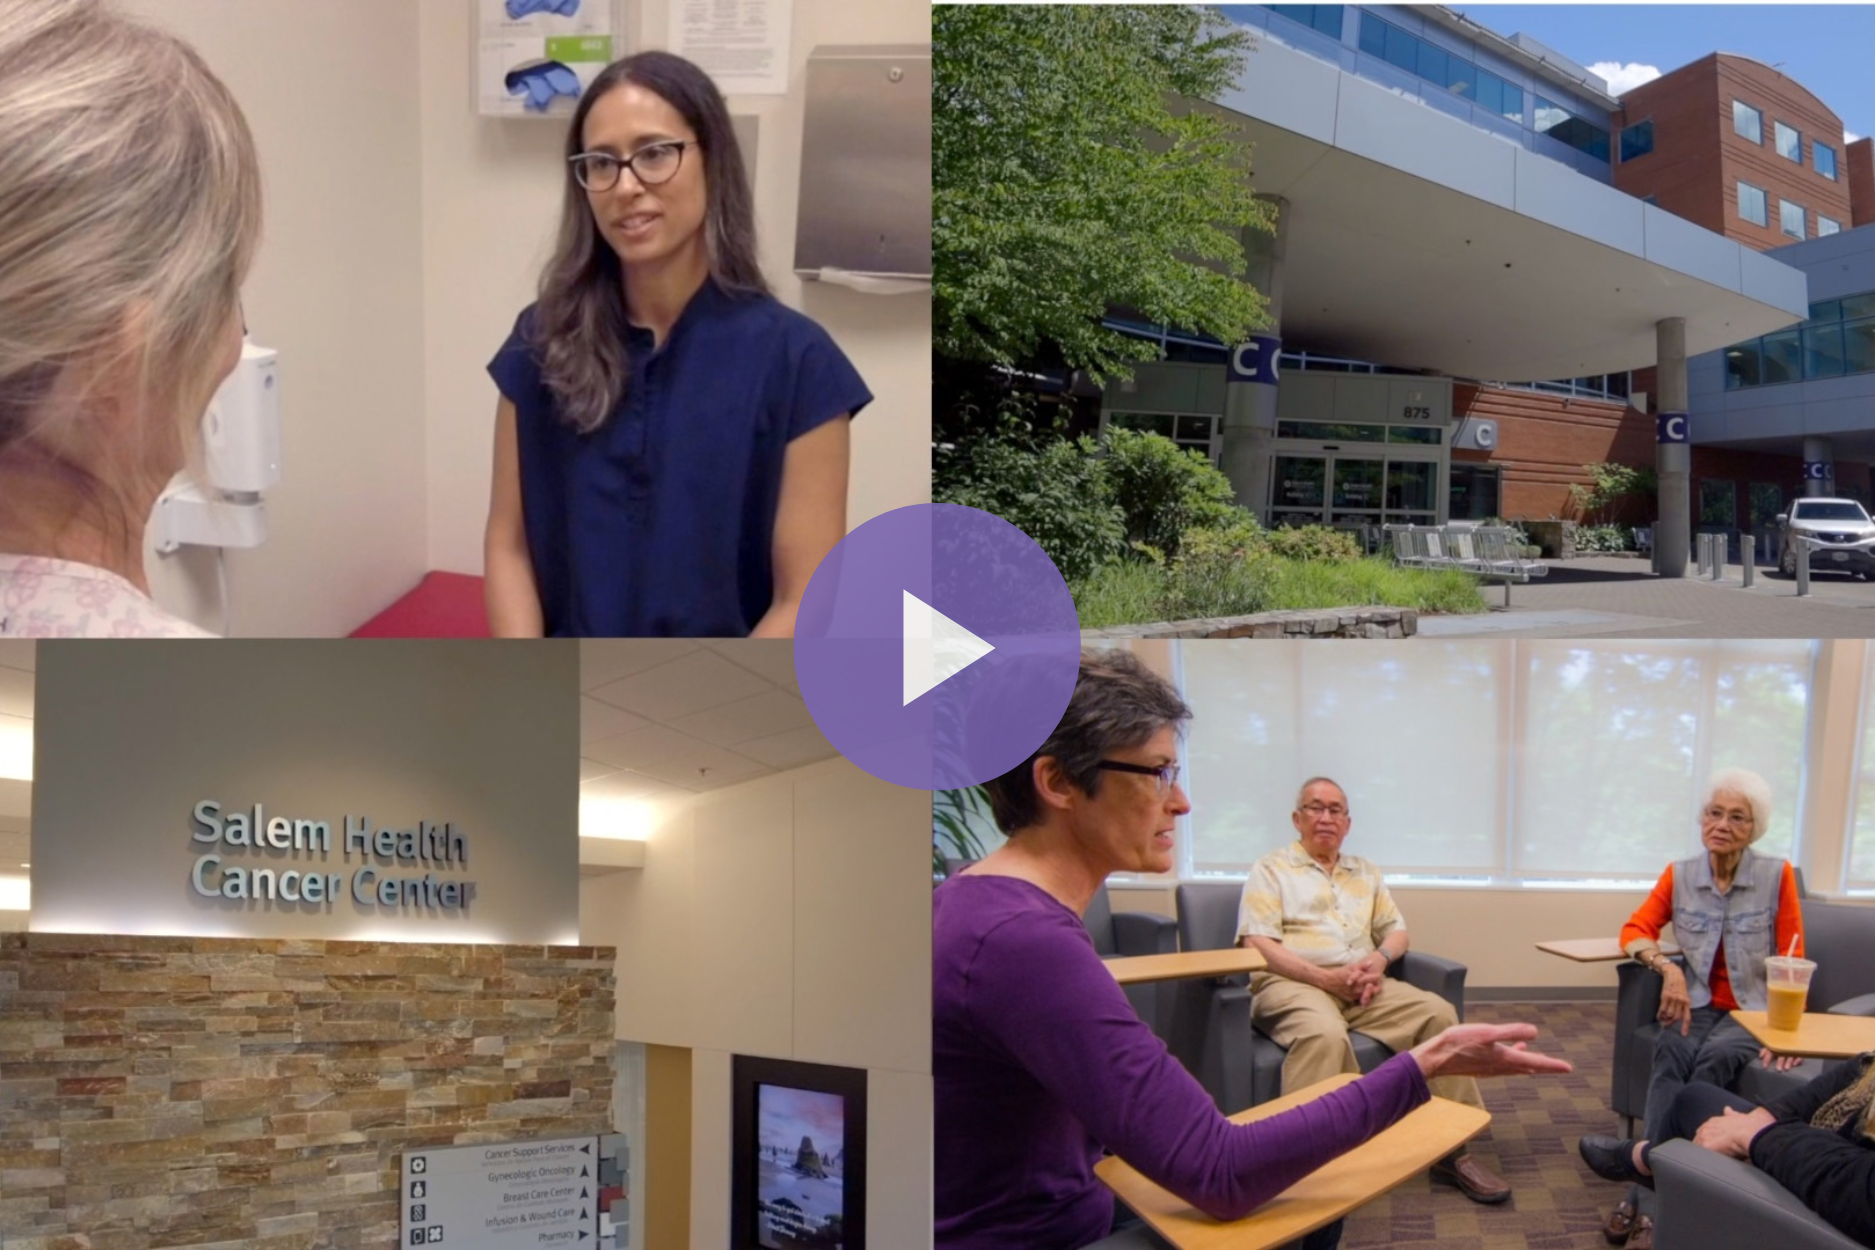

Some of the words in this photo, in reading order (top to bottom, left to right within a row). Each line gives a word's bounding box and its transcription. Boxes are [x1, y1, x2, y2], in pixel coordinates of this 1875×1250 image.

[1233, 342, 1259, 375] C
[1403, 406, 1430, 419] 875
[1476, 424, 1492, 446] C
[1666, 417, 1684, 440] C
[1811, 463, 1823, 478] C
[192, 800, 331, 852] Salem
[344, 815, 468, 862] Health
[192, 854, 342, 903] Cancer
[352, 865, 477, 908] Center
[485, 1150, 511, 1160] Cancer
[512, 1147, 543, 1157] Support
[544, 1143, 575, 1154] Services
[488, 1168, 538, 1183] Gynecologic
[538, 1165, 576, 1177] Oncology
[503, 1192, 529, 1203] Breast
[531, 1190, 549, 1199] Care
[550, 1187, 575, 1197] Center
[485, 1216, 519, 1228] Infusion
[520, 1212, 527, 1223] &
[528, 1209, 556, 1221] Wound
[557, 1208, 575, 1217] Care
[538, 1231, 575, 1242] Pharmacy
